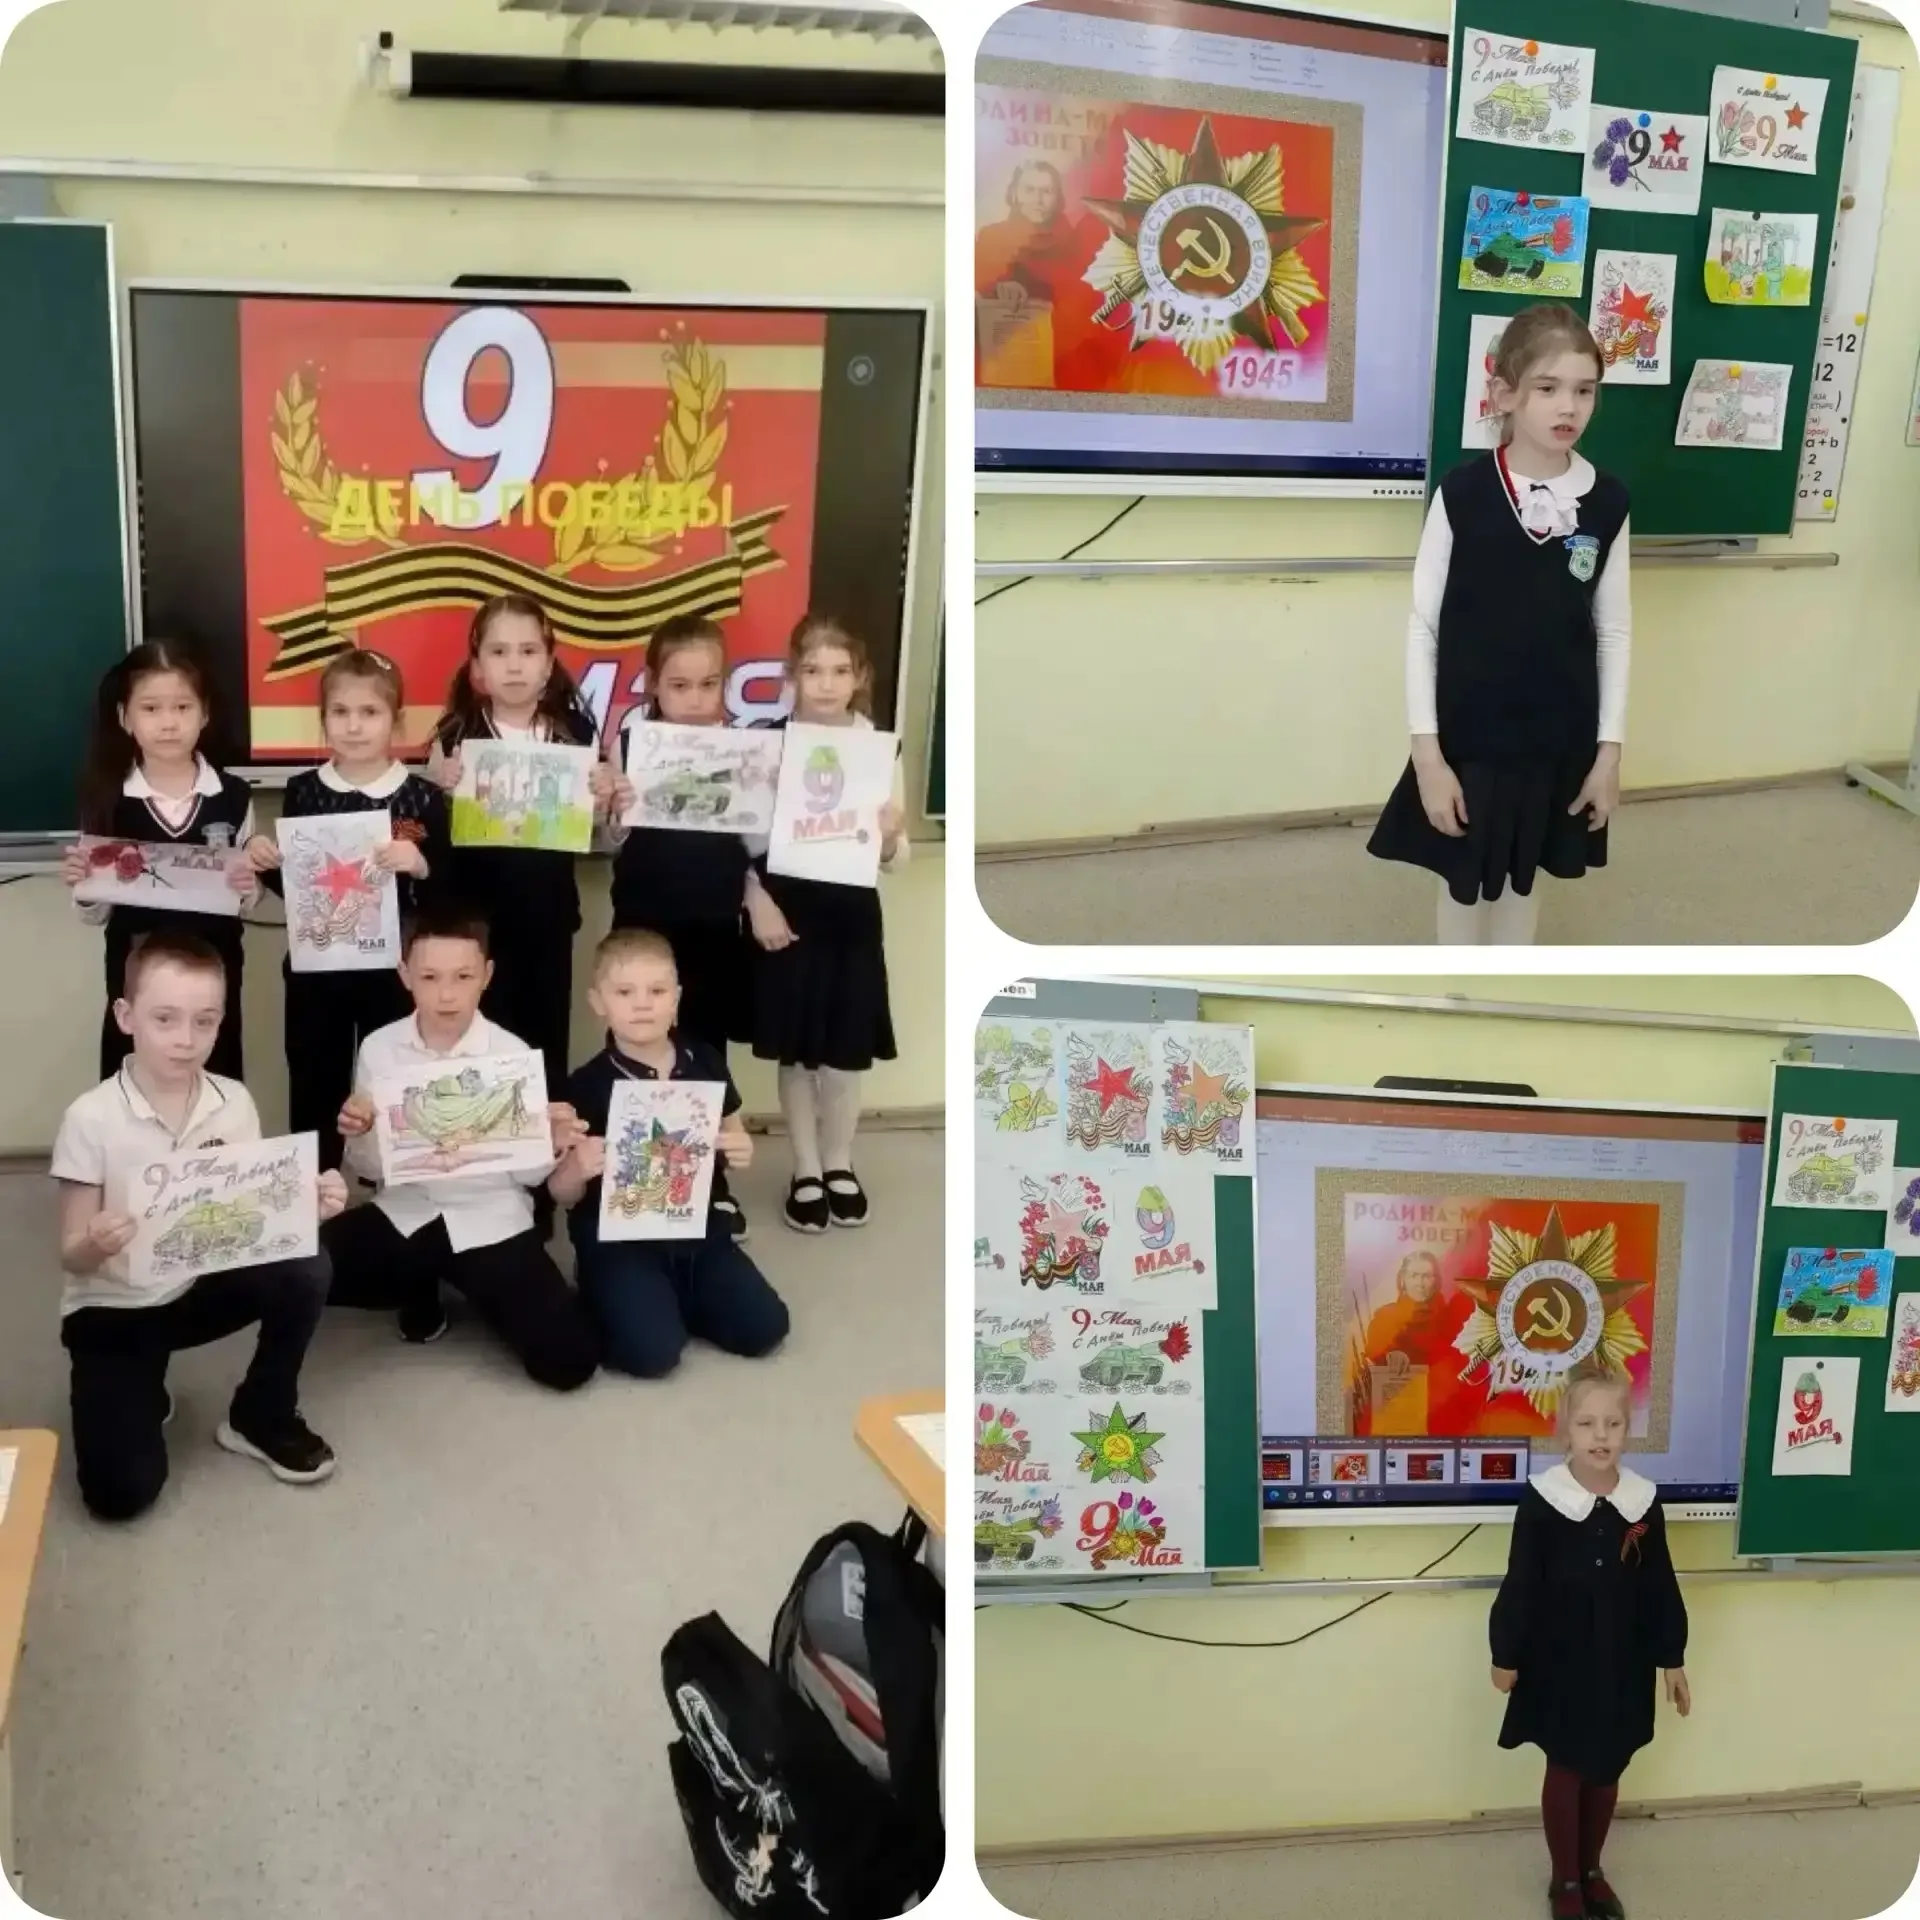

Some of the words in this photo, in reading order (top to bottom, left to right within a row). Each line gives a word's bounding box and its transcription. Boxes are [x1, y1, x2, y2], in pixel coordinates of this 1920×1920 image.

[1473, 37, 1490, 69] 9
[1756, 115, 1777, 157] 9
[1628, 129, 1651, 167] 9
[1648, 154, 1689, 172] МАЯ
[1823, 333, 1856, 352] =12
[1224, 355, 1294, 390] 1945
[1637, 359, 1659, 370] МАЯ
[410, 304, 554, 530] 9
[1830, 436, 1839, 448] b
[1808, 453, 1817, 465] 2
[331, 478, 482, 537] ДЕНЬ
[500, 480, 734, 538] ПОБЕДЫ
[803, 746, 845, 813] 9
[793, 809, 859, 841] МАЯ
[357, 938, 386, 950] МАЯ
[1789, 1119, 1805, 1146] 9
[1124, 1143, 1151, 1154] МАЯ
[1217, 1148, 1243, 1159] МАЯ
[143, 1163, 170, 1203] 9
[1136, 1186, 1176, 1249] 9
[1135, 1242, 1192, 1276] МАЯ
[1078, 1281, 1105, 1292] МАЯ
[1071, 1308, 1091, 1336] 9
[1093, 1310, 1142, 1329] Мая
[1087, 1331, 1124, 1349] Днём
[1788, 1418, 1833, 1447] МАЯ
[995, 1458, 1052, 1483] Мая
[1002, 1492, 1060, 1515] Победы!
[1076, 1501, 1121, 1552] 9
[1131, 1546, 1184, 1566] Мая
